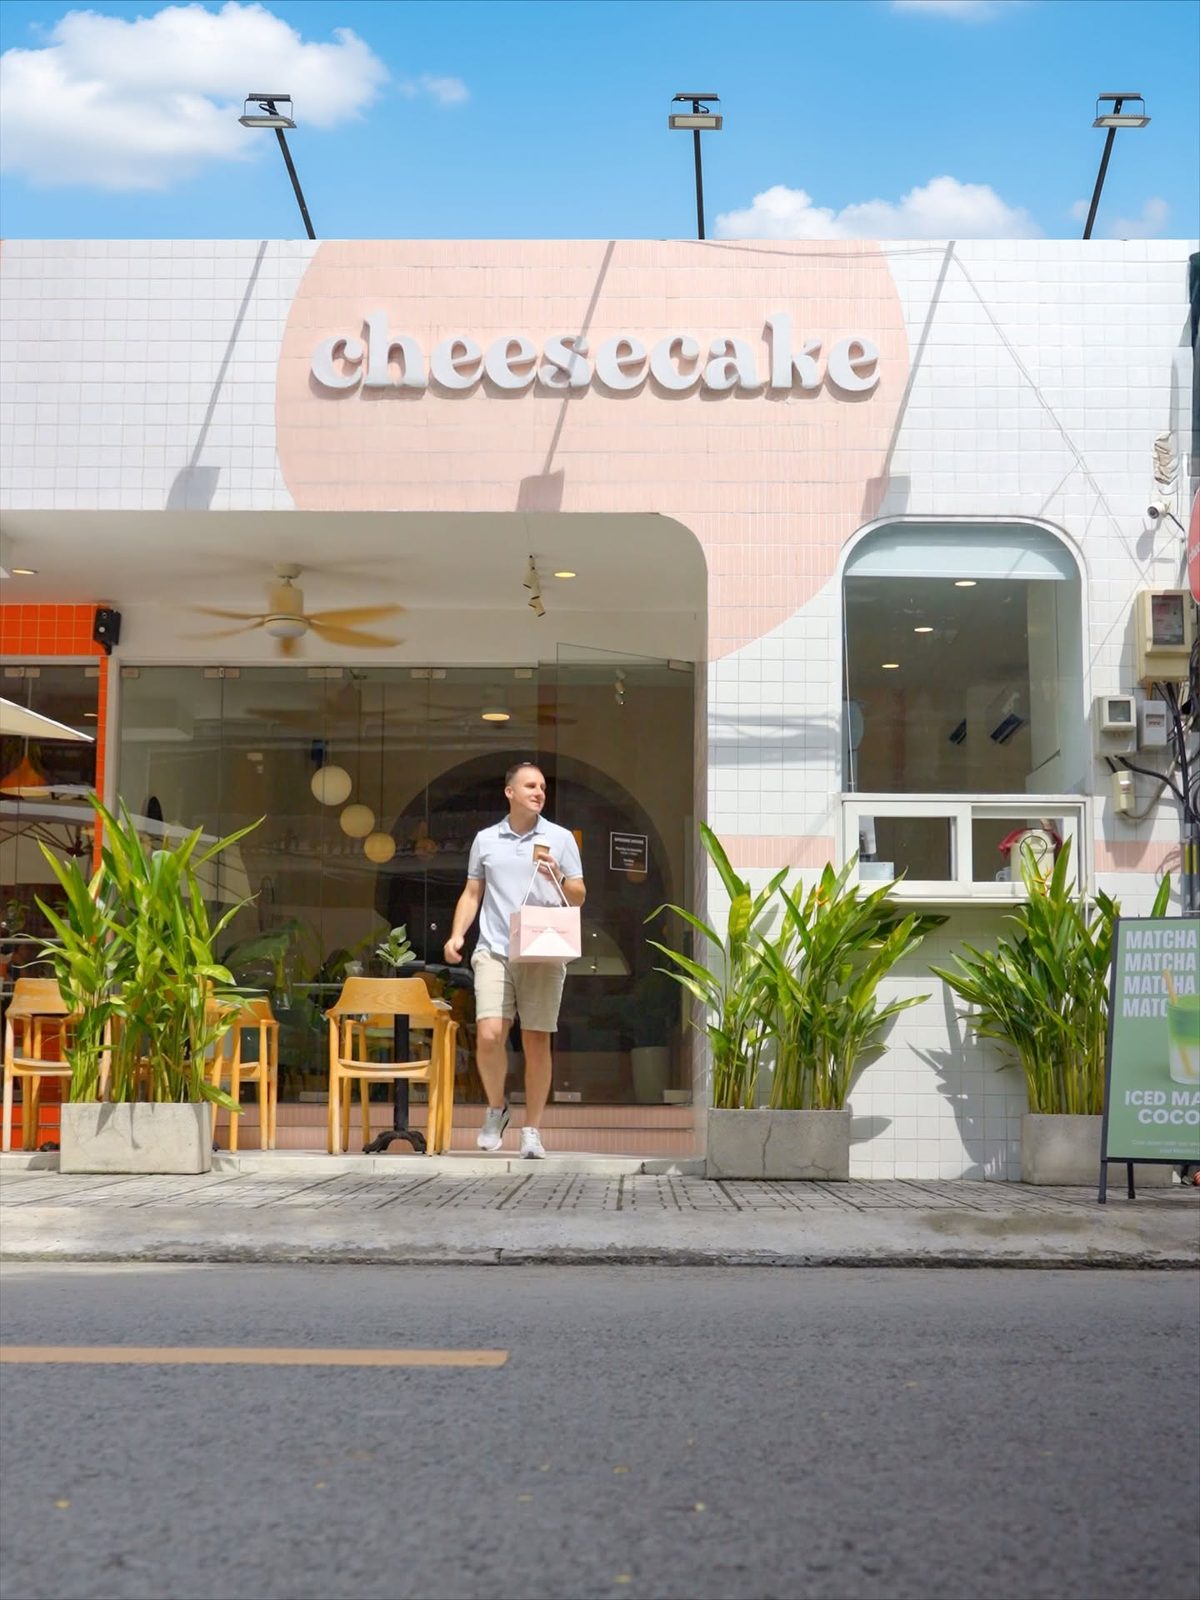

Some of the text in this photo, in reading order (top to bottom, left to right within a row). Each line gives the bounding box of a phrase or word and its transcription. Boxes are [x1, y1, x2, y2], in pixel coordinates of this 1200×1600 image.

[310, 311, 881, 394] cheesecake
[1126, 929, 1197, 949] MATCHA
[1124, 952, 1196, 972] MATCHA
[1125, 1090, 1167, 1105] ICED
[1138, 1108, 1200, 1125] COCO
